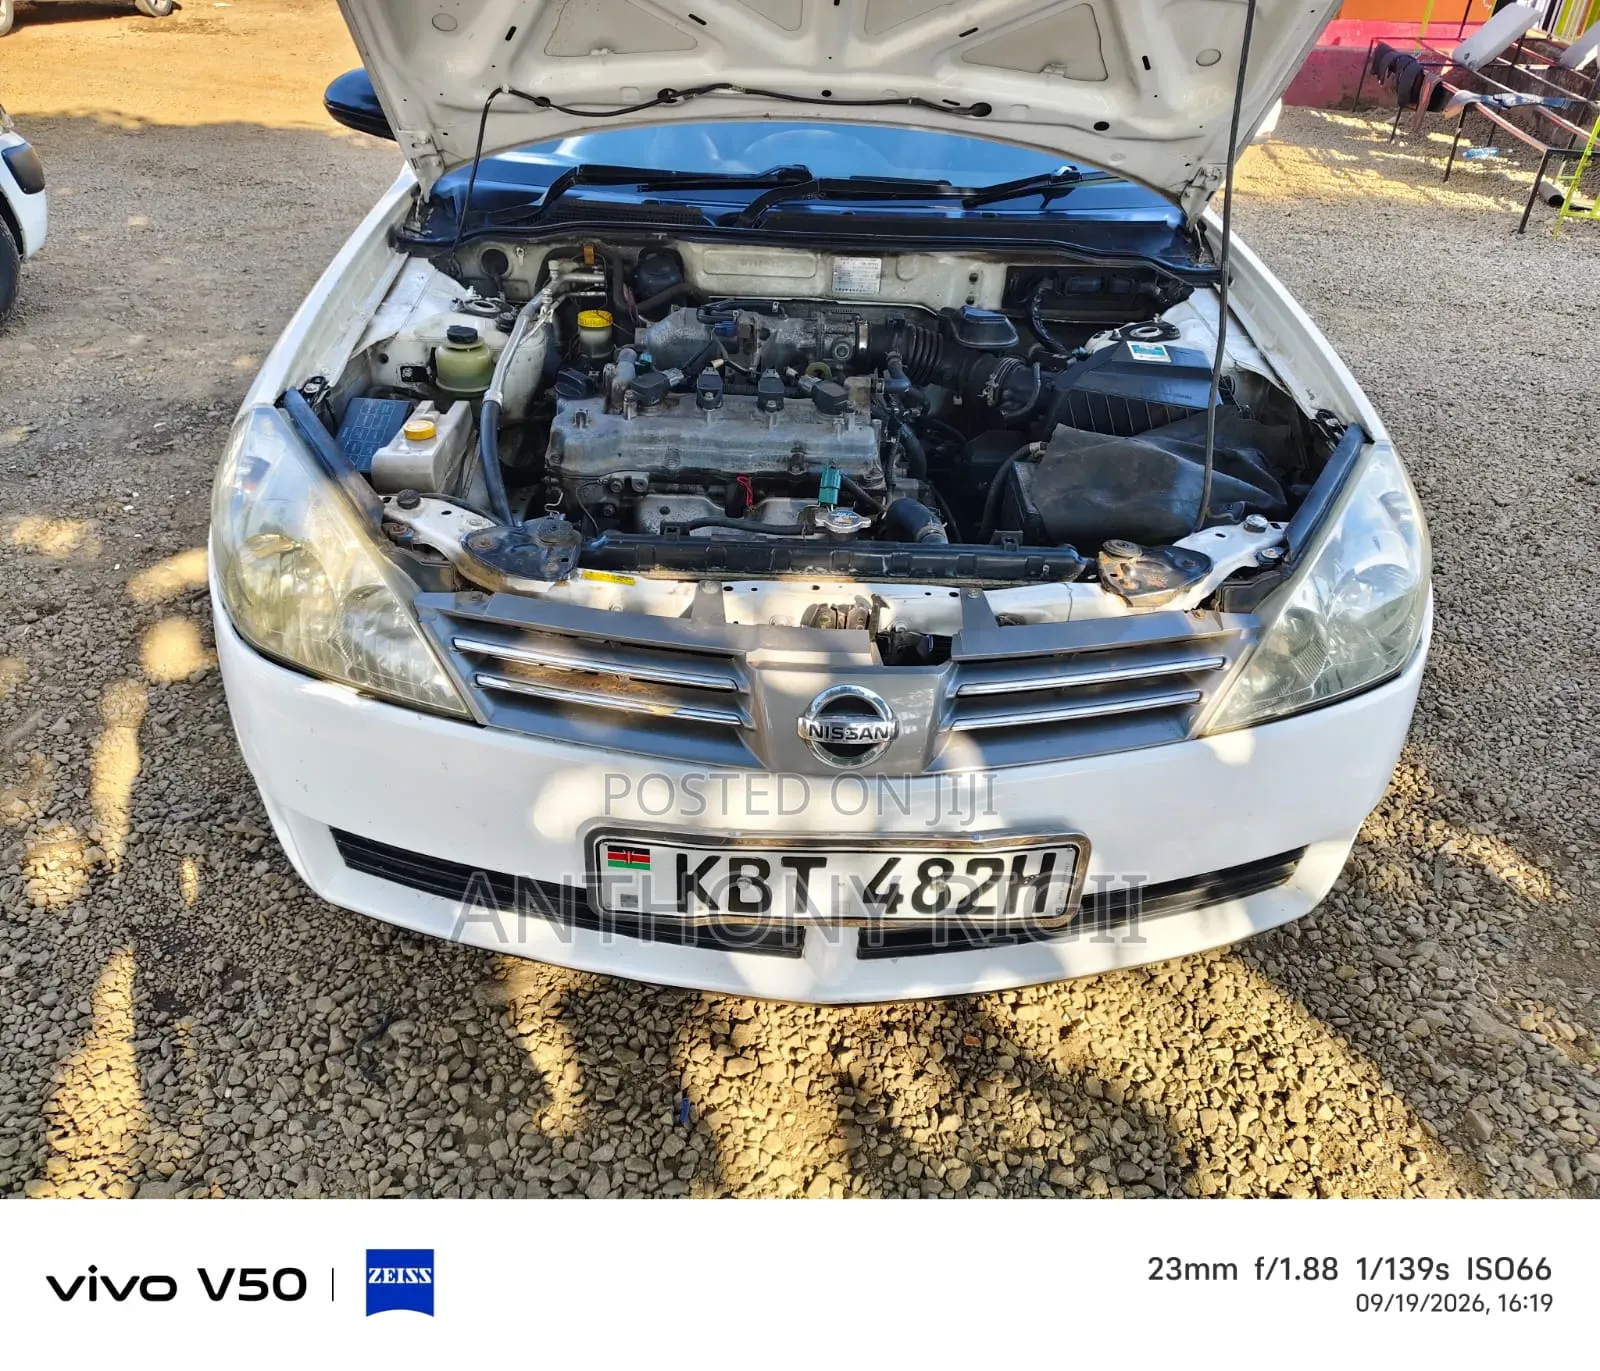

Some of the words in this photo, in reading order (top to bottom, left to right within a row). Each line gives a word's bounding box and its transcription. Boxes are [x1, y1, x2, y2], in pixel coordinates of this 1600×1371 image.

[808, 724, 888, 740] NISSAN
[676, 853, 828, 914] KBT
[862, 852, 1057, 915] 482H
